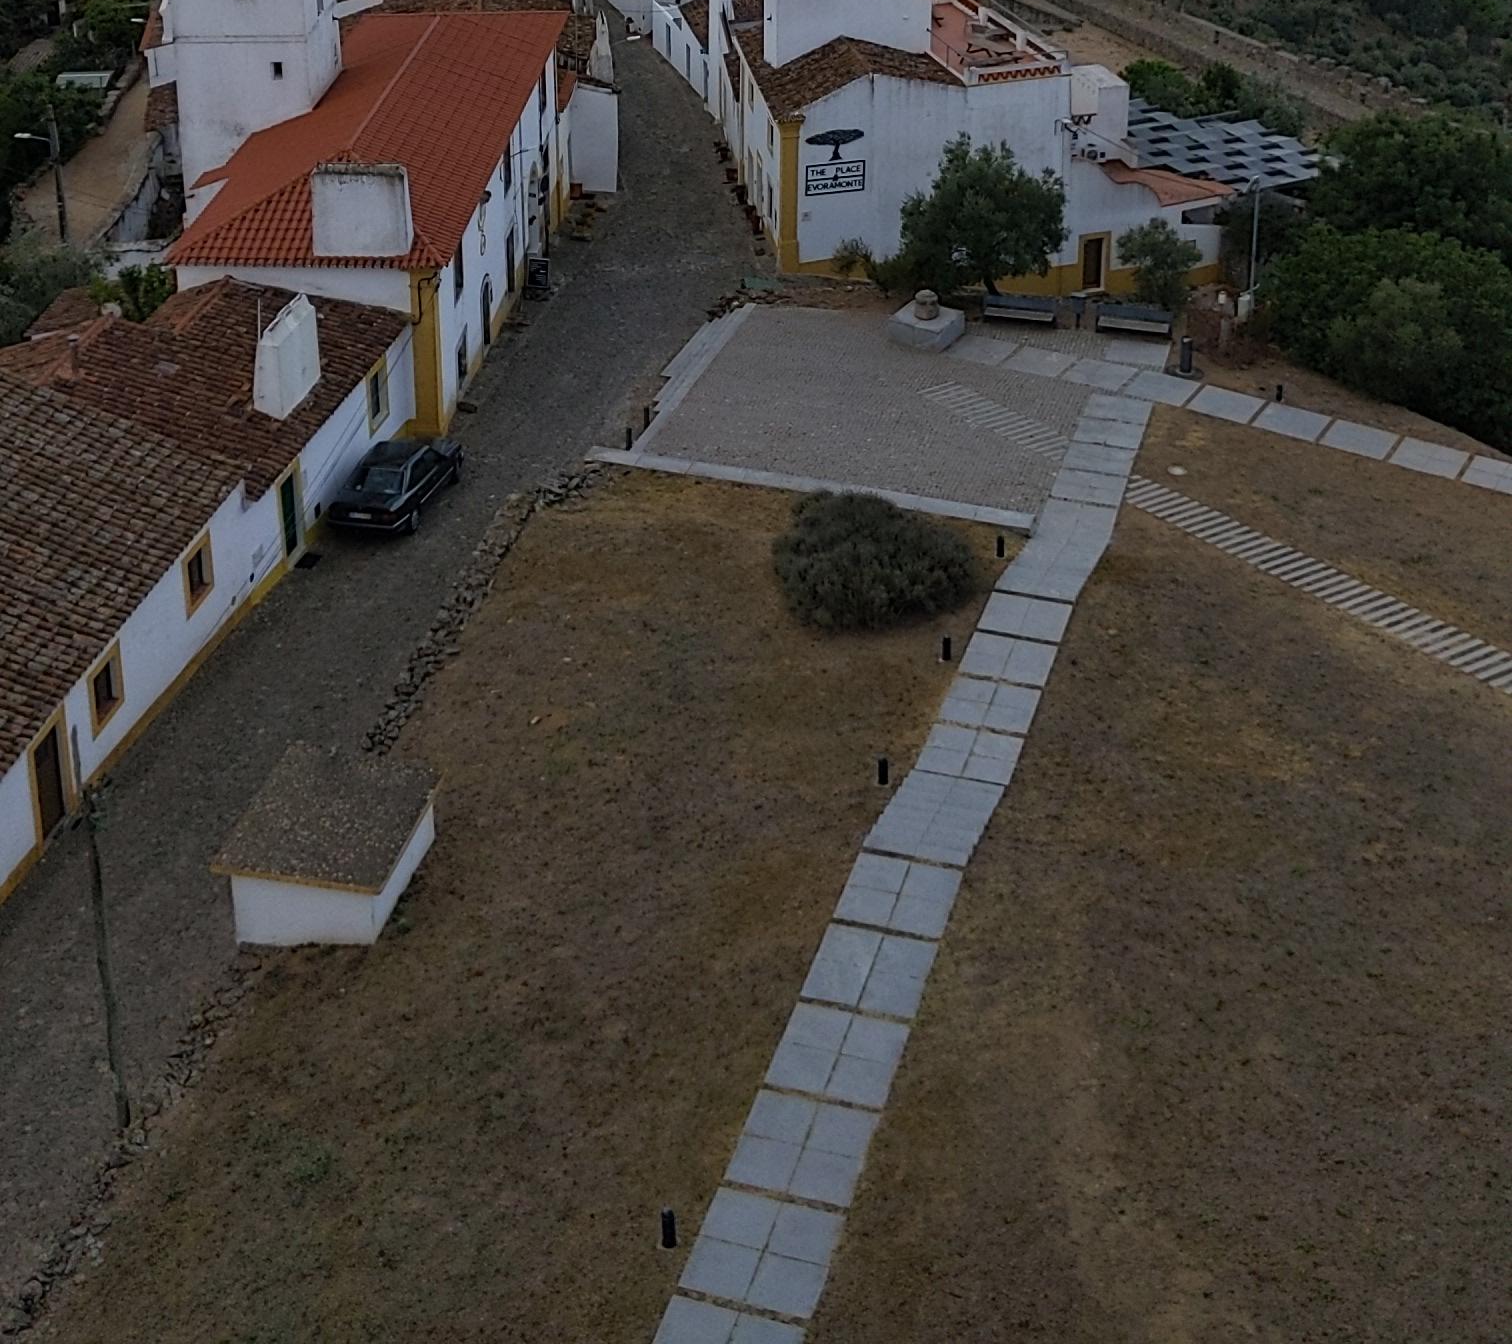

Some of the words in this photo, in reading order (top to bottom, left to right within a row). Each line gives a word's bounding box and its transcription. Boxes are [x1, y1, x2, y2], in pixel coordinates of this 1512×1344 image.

[810, 168, 827, 177] THE
[835, 164, 861, 174] PLACE
[807, 179, 863, 192] EVORAMONTE
